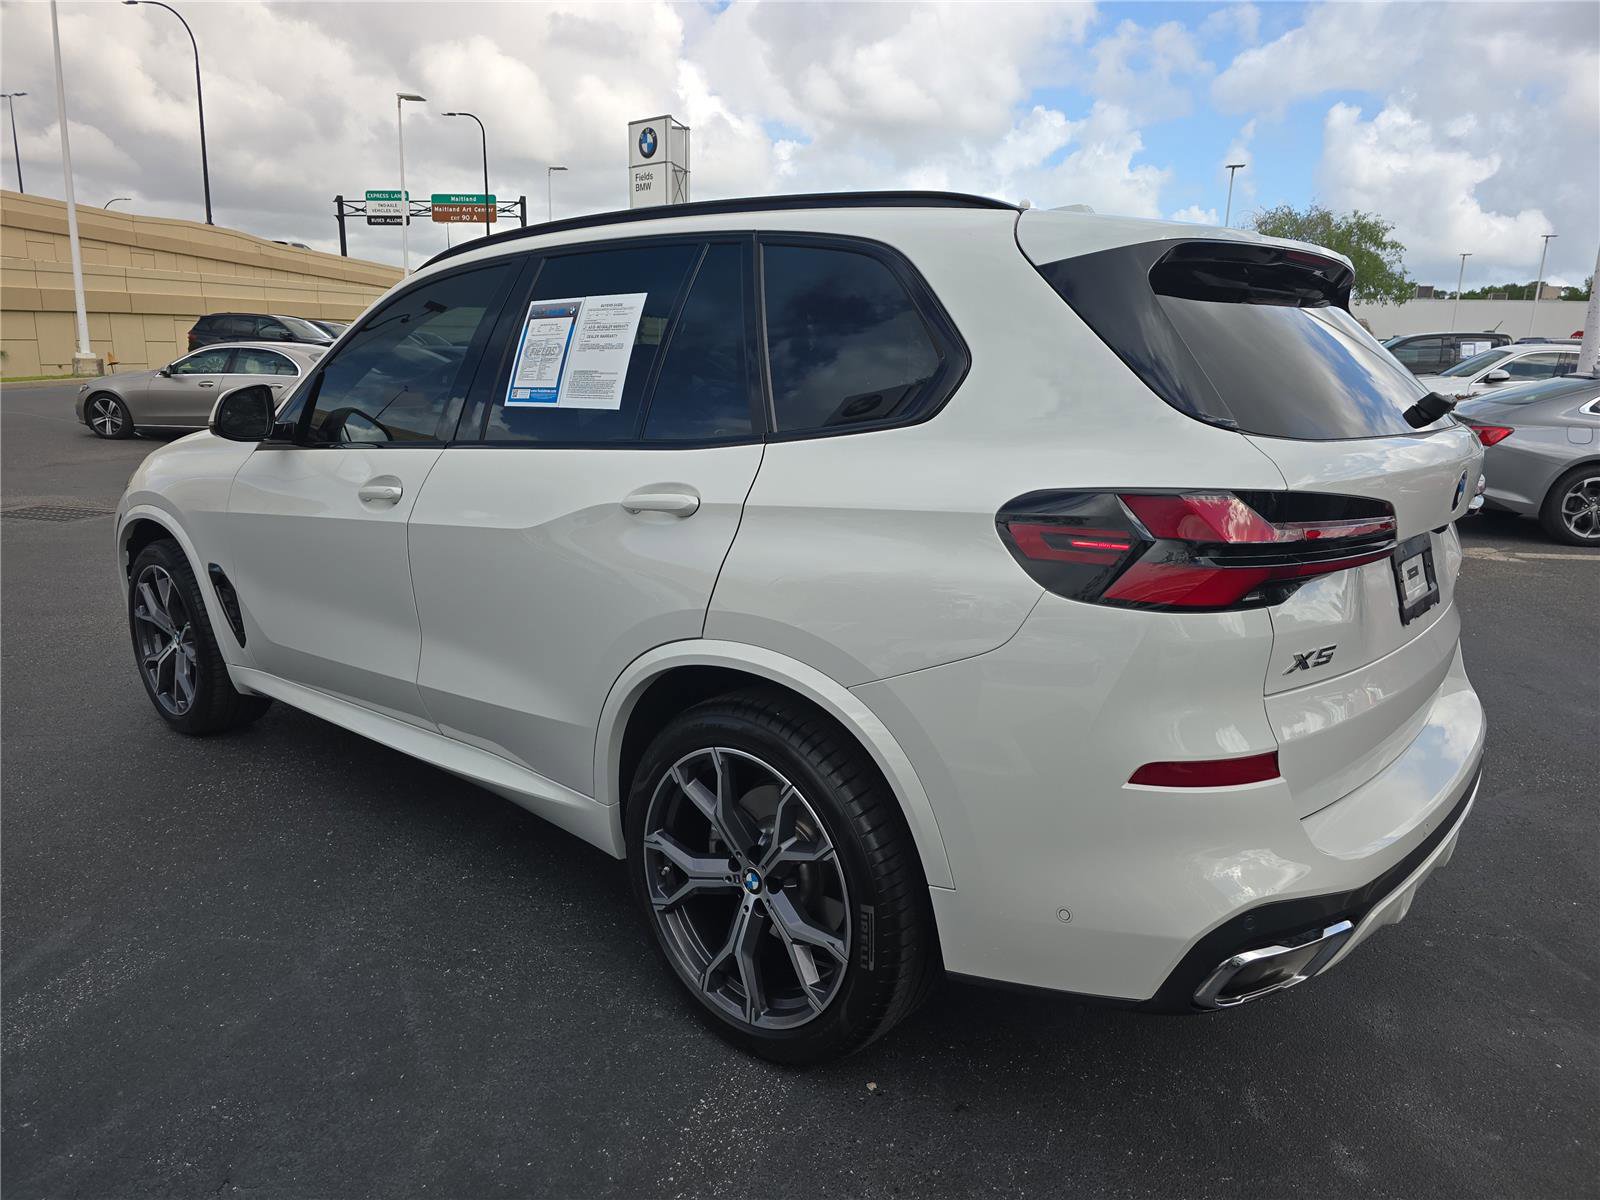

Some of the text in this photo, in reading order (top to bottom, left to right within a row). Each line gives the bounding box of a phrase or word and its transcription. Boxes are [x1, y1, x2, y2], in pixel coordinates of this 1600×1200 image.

[635, 172, 654, 181] Fields
[635, 182, 652, 192] BMW
[1282, 644, 1337, 675] X5
